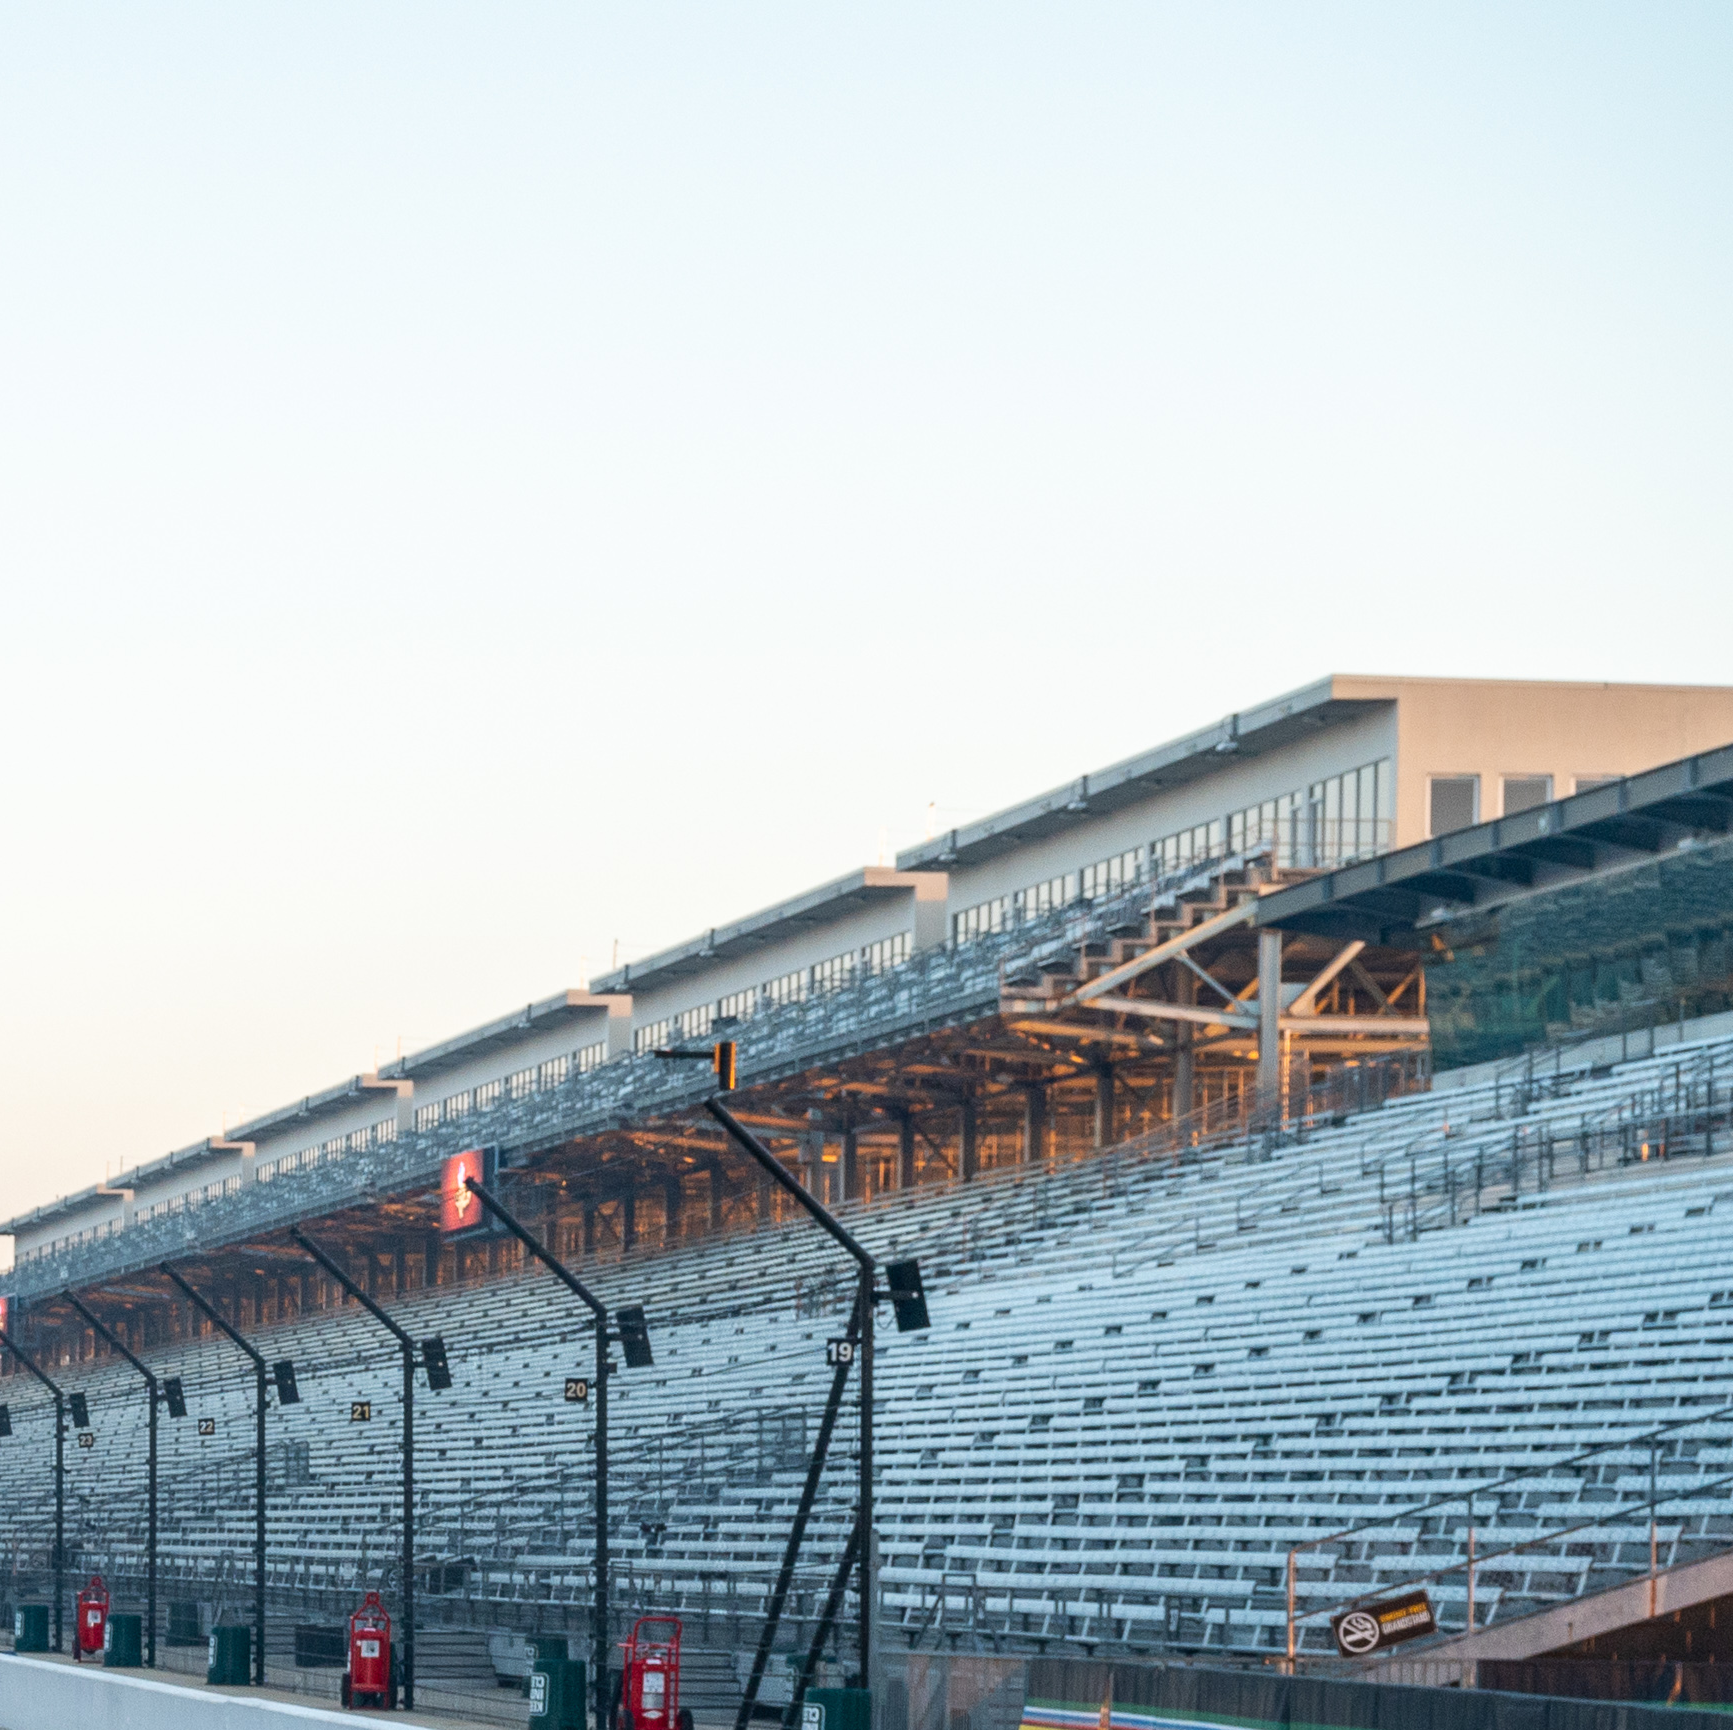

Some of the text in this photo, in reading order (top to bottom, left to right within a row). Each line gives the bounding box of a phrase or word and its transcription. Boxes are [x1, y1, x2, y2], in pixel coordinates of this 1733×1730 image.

[829, 1342, 852, 1362] 19
[566, 1382, 586, 1398] 20
[352, 1403, 370, 1420] 21
[199, 1420, 215, 1433] 22
